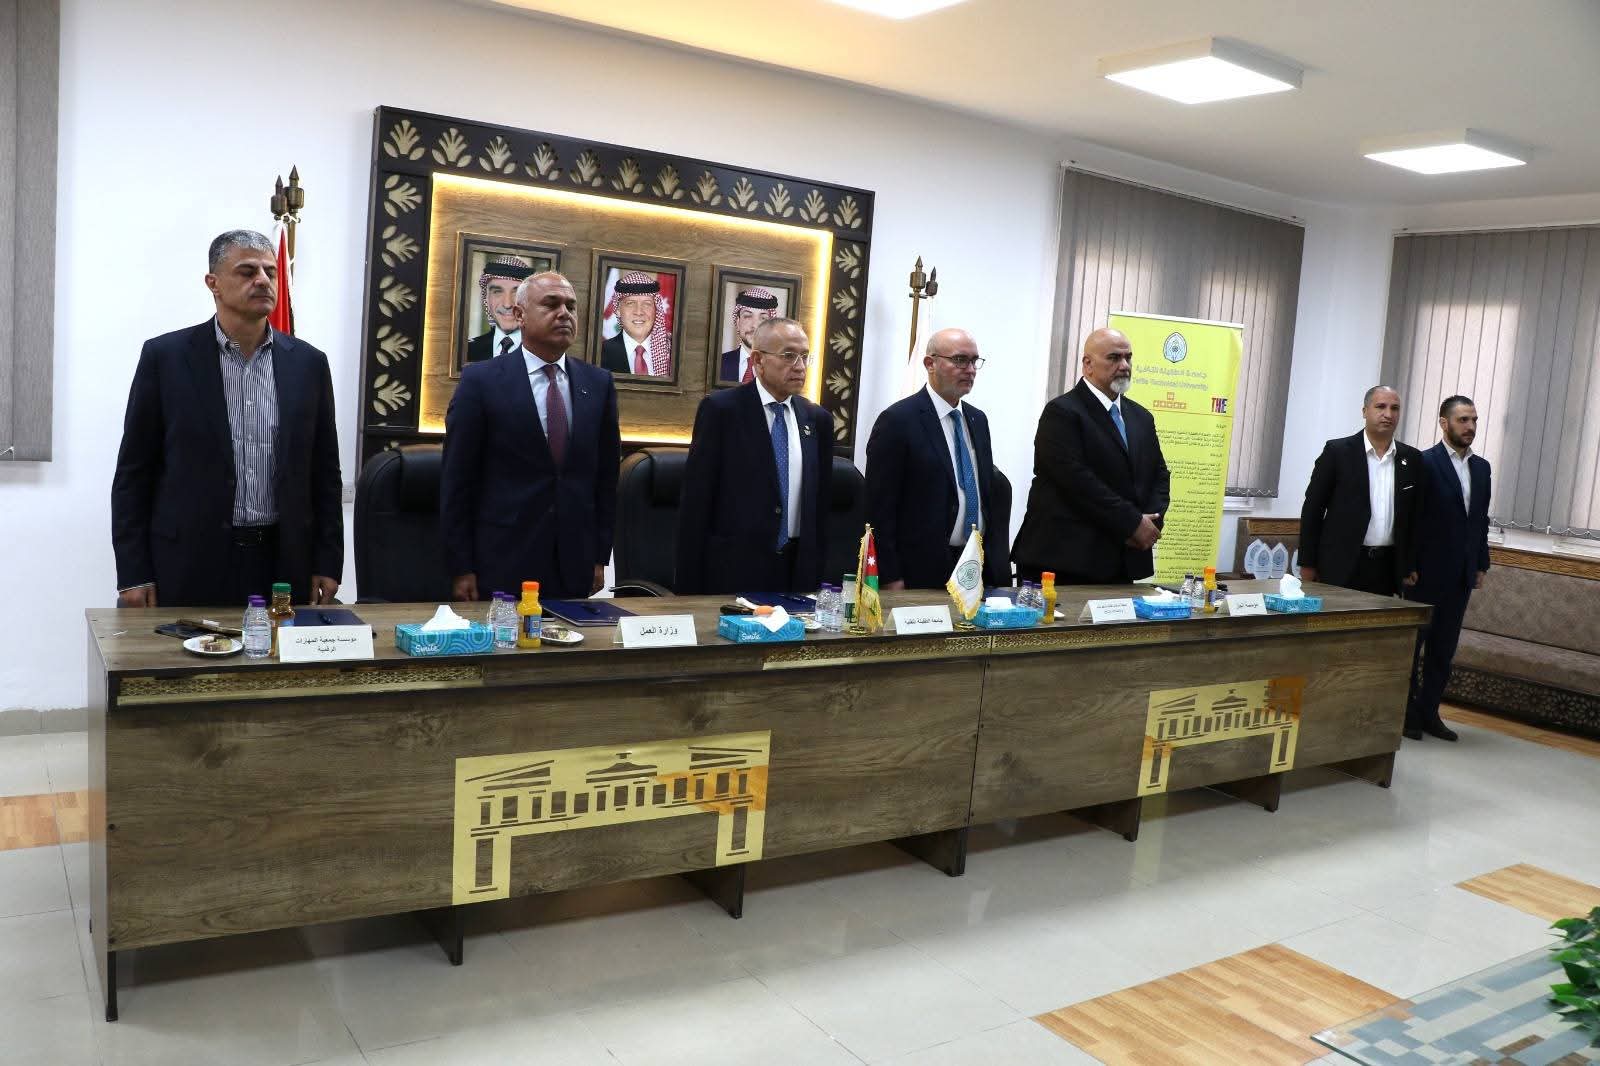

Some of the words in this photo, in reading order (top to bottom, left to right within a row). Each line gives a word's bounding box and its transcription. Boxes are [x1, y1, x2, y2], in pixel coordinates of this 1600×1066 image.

[1211, 397, 1228, 413] THE
[640, 626, 655, 636] العمل
[658, 626, 678, 636] وزارة
